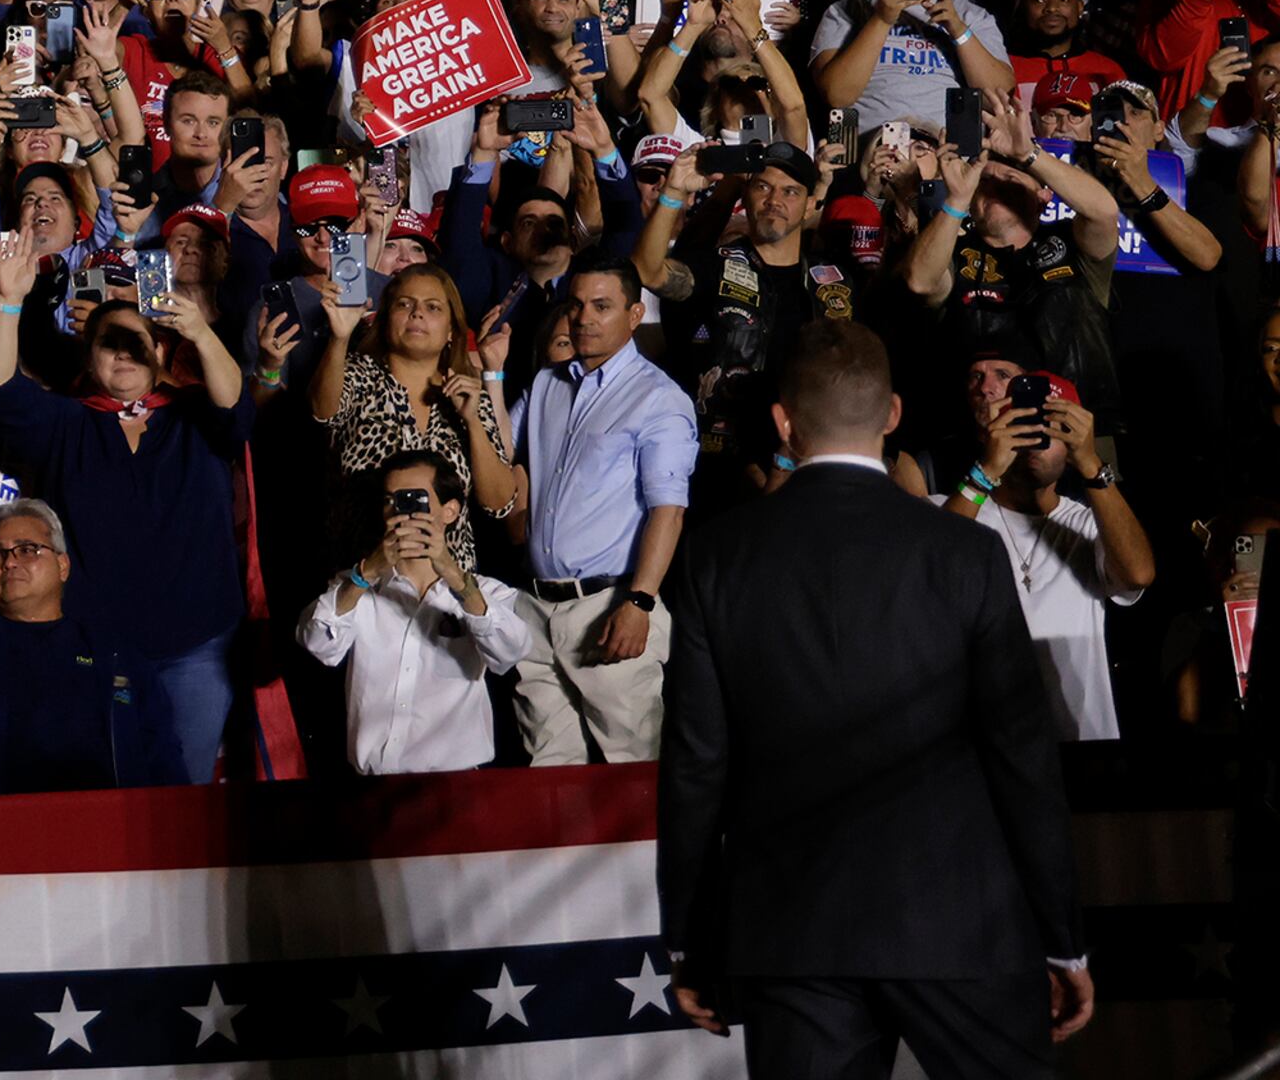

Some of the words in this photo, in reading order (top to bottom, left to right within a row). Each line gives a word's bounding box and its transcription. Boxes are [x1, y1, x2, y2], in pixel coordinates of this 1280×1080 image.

[361, 16, 482, 84] AMERICA
[371, 3, 449, 52] MAKE
[905, 39, 937, 51] FOR
[381, 43, 471, 96] GREAT
[879, 46, 947, 69] TRUM
[392, 63, 487, 120] AGAIN!
